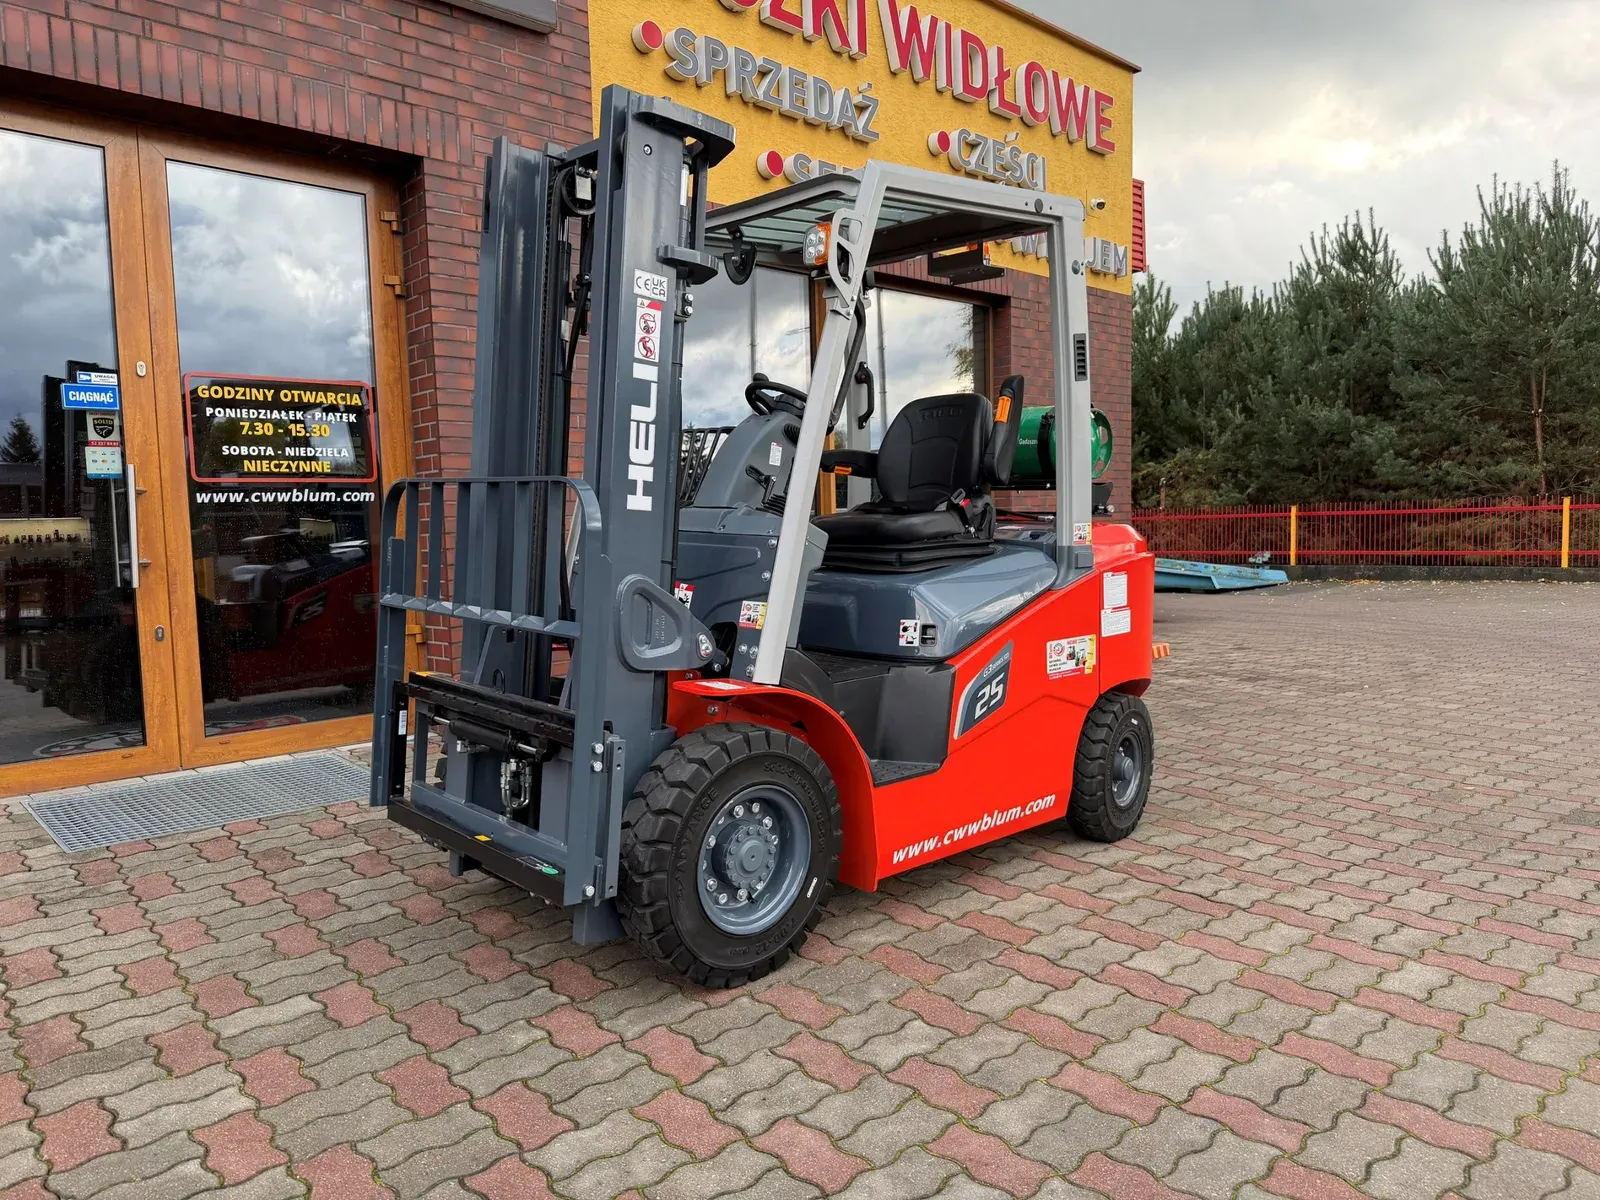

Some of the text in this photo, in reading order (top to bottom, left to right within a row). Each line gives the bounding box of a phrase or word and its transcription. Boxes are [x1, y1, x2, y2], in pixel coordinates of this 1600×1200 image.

[665, 27, 880, 143] SPRZEDAŻ
[878, 0, 1116, 154] WIDŁOWE
[68, 390, 114, 405] CIĄGNĄĆ
[197, 385, 362, 406] GODZINY OTWARCIA
[205, 407, 304, 420] PONIEDZIAŁEK
[314, 411, 357, 424] PIĄTEK
[239, 421, 274, 436] 7.30
[288, 424, 330, 437] 15.30
[626, 362, 659, 511] HELI
[222, 445, 275, 456] SOBOTA
[285, 447, 349, 457] NIEDZIELA
[243, 460, 331, 473] NIECZYNNE
[196, 488, 375, 503] www.cwwblum.com
[974, 672, 1005, 719] 25
[892, 793, 1056, 865] www.cwwblum.com
